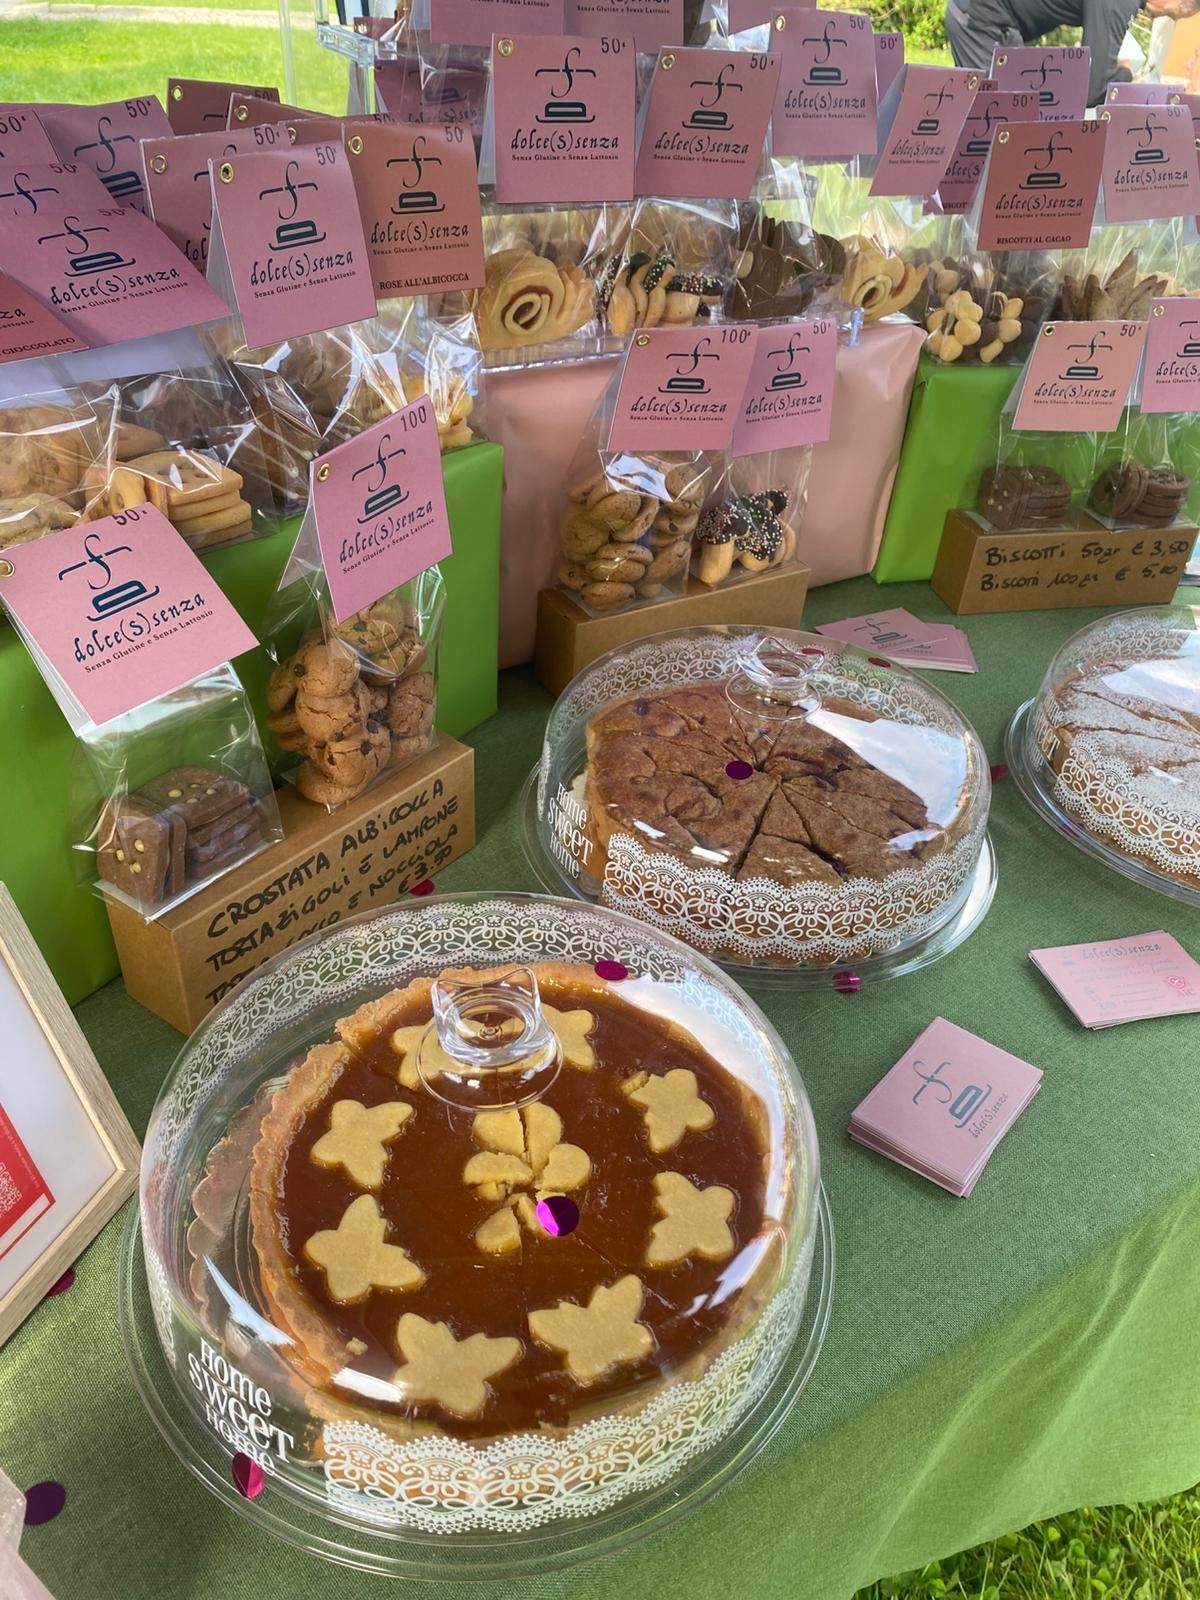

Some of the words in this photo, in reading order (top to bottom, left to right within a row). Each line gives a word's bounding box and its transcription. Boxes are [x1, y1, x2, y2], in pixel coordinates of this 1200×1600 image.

[511, 128, 619, 152] dolce(S)senza
[655, 132, 749, 154] dolce(S)senza
[996, 194, 1083, 212] dolce(S)senza
[371, 220, 468, 244] dolce(S)senza
[251, 251, 353, 286] dolce(S)senza
[51, 268, 180, 305] dolce(S)senza
[380, 280, 402, 290] ROSE
[404, 273, 470, 288] ALL'ALBICOCCA
[2, 337, 76, 355] CIOCCOLATO
[631, 396, 726, 414] dolce(S)senza
[746, 394, 822, 414] dolce(S)senza
[340, 501, 432, 563] dolce(S)senza
[1150, 540, 1189, 557] 3,50
[74, 593, 205, 662] dolce(S)senza
[84, 659, 112, 673] Senza
[113, 643, 146, 660] Glutine
[153, 627, 178, 641] Senza
[179, 610, 214, 628] Lattosio
[206, 921, 274, 972] TORTA
[358, 853, 373, 874] E
[383, 795, 458, 858] LAMPONE
[208, 851, 330, 938] CROSTATA
[348, 890, 362, 910] E
